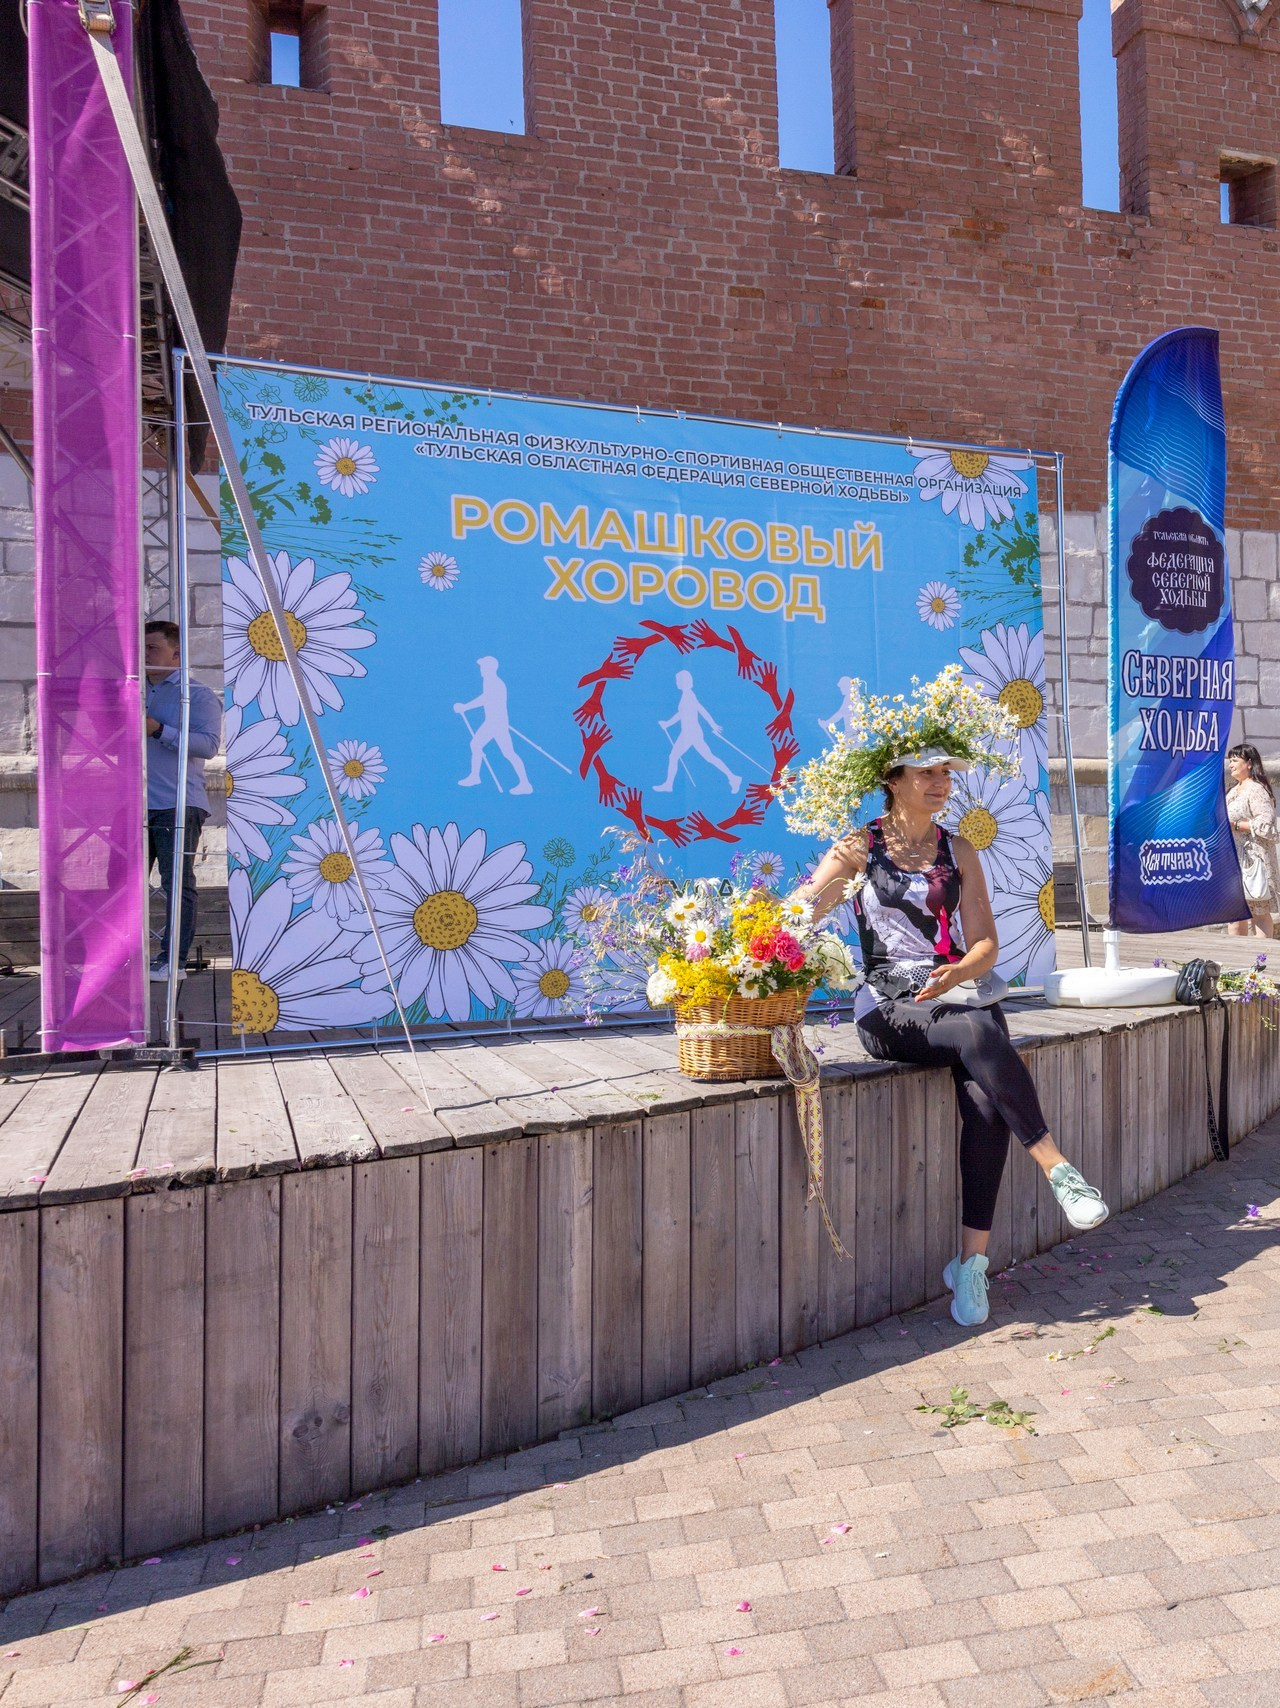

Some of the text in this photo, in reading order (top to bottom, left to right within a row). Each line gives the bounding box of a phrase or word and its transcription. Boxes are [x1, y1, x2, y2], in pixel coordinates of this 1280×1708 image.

[247, 403, 1023, 499] ТУЛЬСКАЯ РЕГИОНАЛЬНАЯ ФИЗКУЛЬТУРНО-СПОРТИВНАЯ ОБЩЕСТВЕННАЯ ОРГАНИЗАЦИЯ
[415, 442, 911, 503] «ТУЛЬСКАЯ ОБЛАСТНАЯ ФЕДЕРАЦИЯ СЕВЕРНОЙ ХОДЬБЫ»
[452, 495, 883, 571] РОМАШКОВЫЙ
[1146, 552, 1215, 574] ФЕДЕРАЦИЯ
[1152, 572, 1211, 592] СЕВЕРНОЙ
[545, 557, 826, 623] ХОРОВОД
[1159, 588, 1207, 608] ХОДЬБЫ
[1122, 649, 1234, 701] СЕВЕРНАЯ
[1139, 707, 1220, 759] ХОДЬБА
